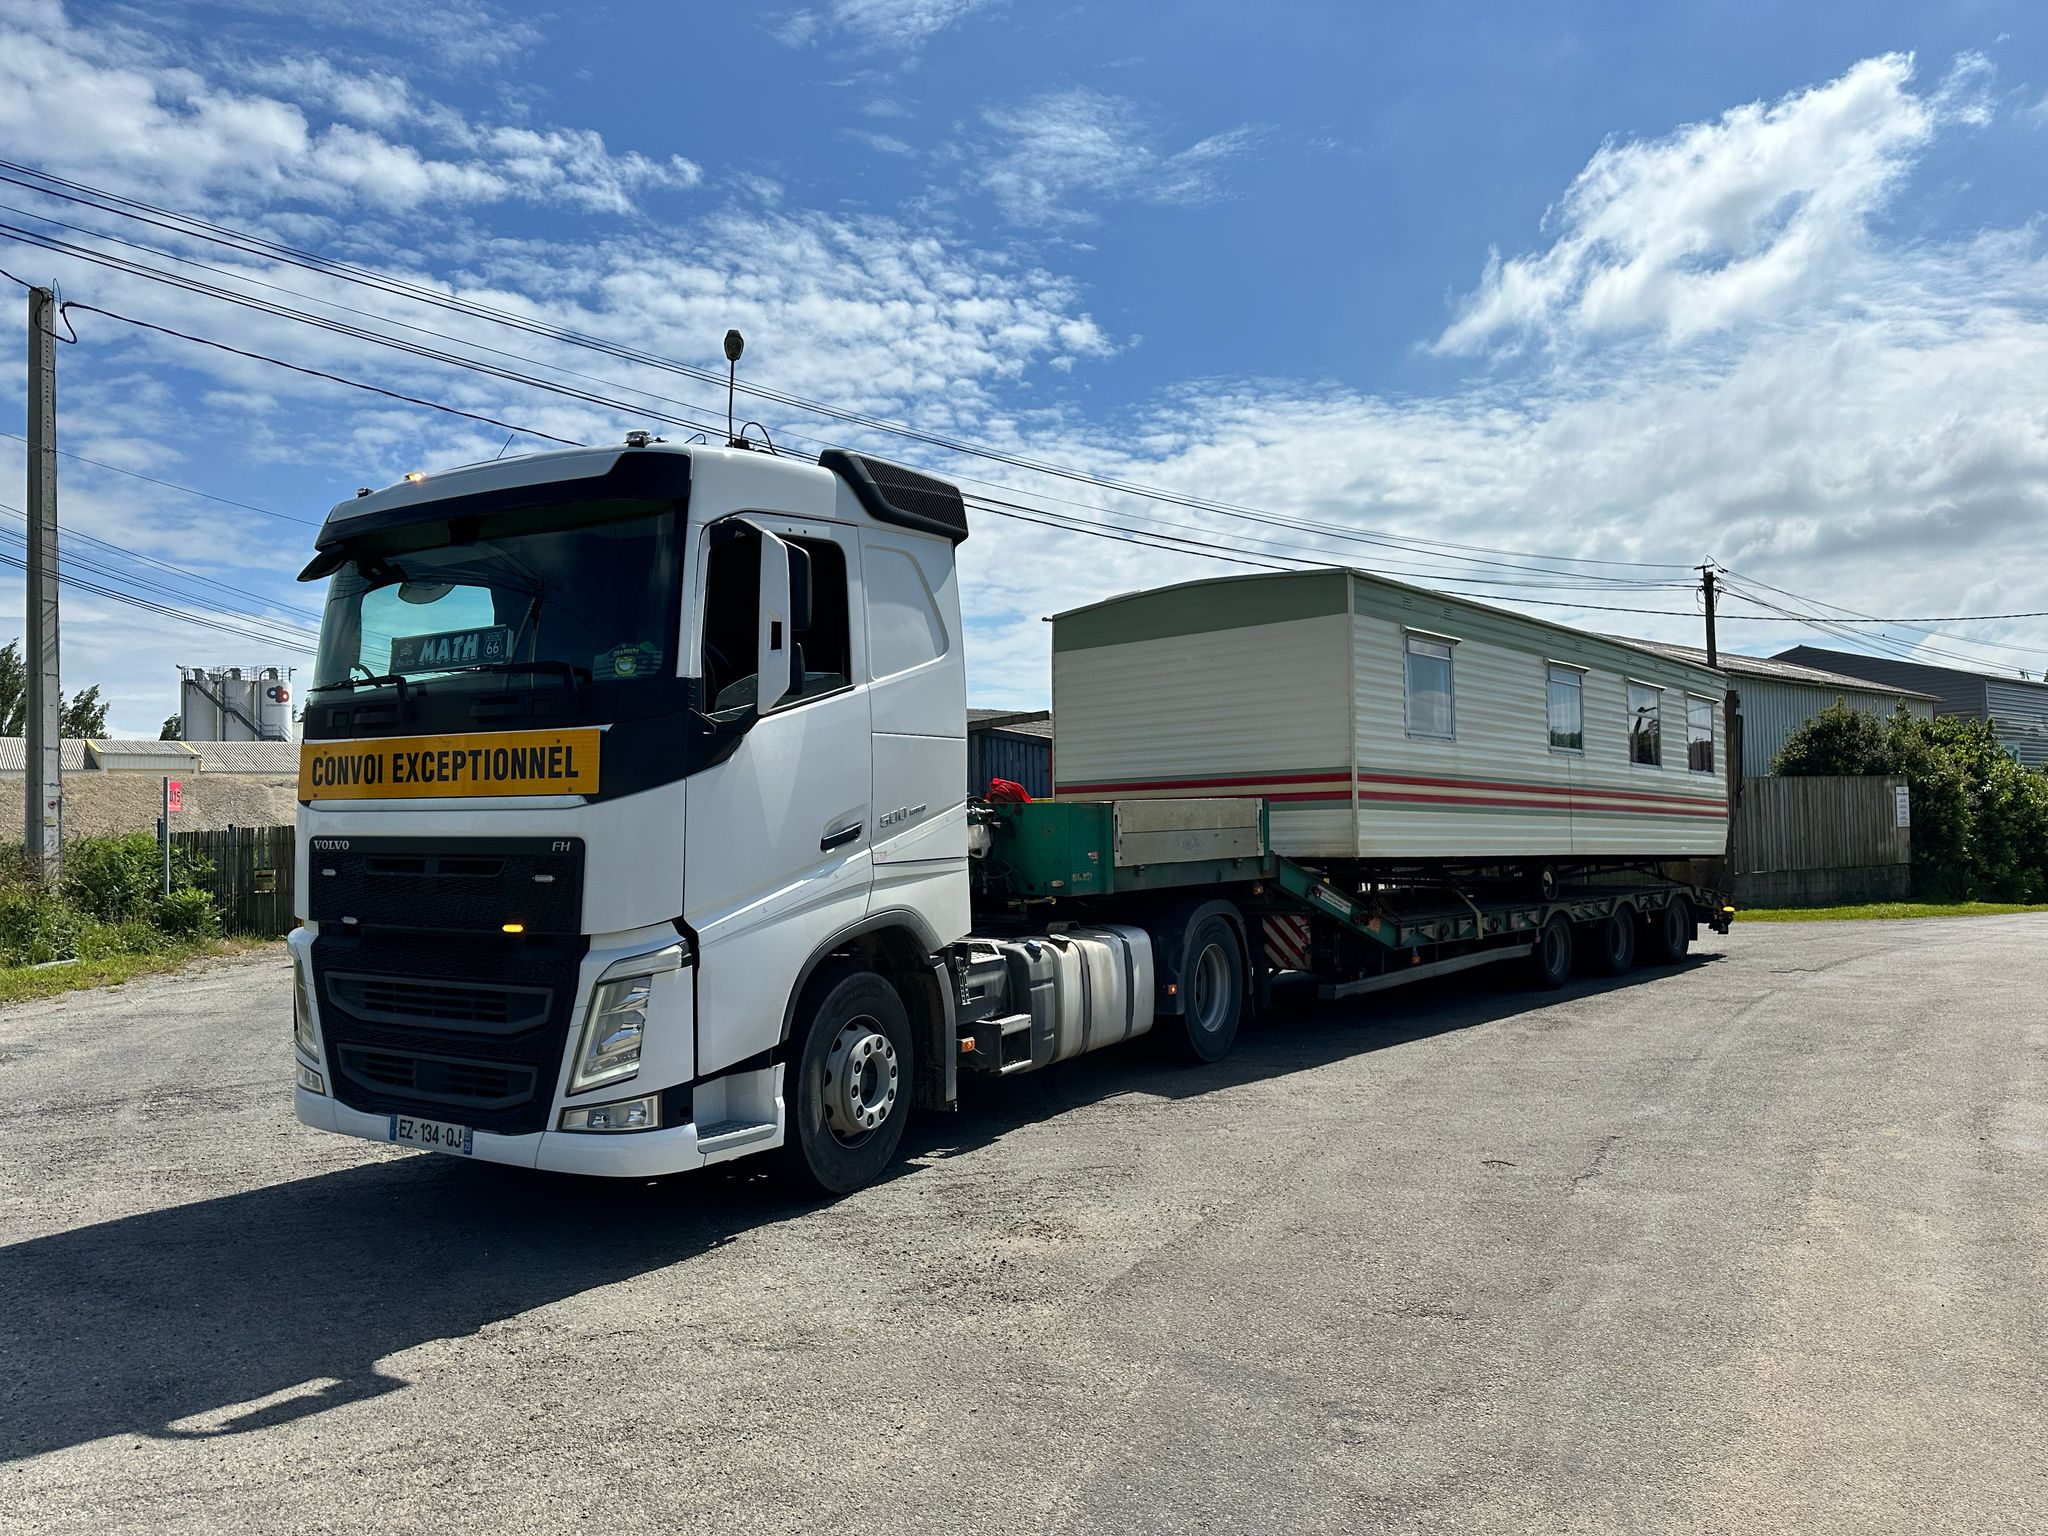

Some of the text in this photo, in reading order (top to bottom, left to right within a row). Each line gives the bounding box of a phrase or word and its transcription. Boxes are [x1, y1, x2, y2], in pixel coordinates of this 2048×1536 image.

[419, 633, 479, 665] MATH
[486, 641, 500, 655] 66
[312, 746, 579, 787] CONVOI EXCEPTIONNEL
[880, 806, 906, 828] 500
[313, 840, 350, 850] VOLVO
[552, 841, 571, 851] FH
